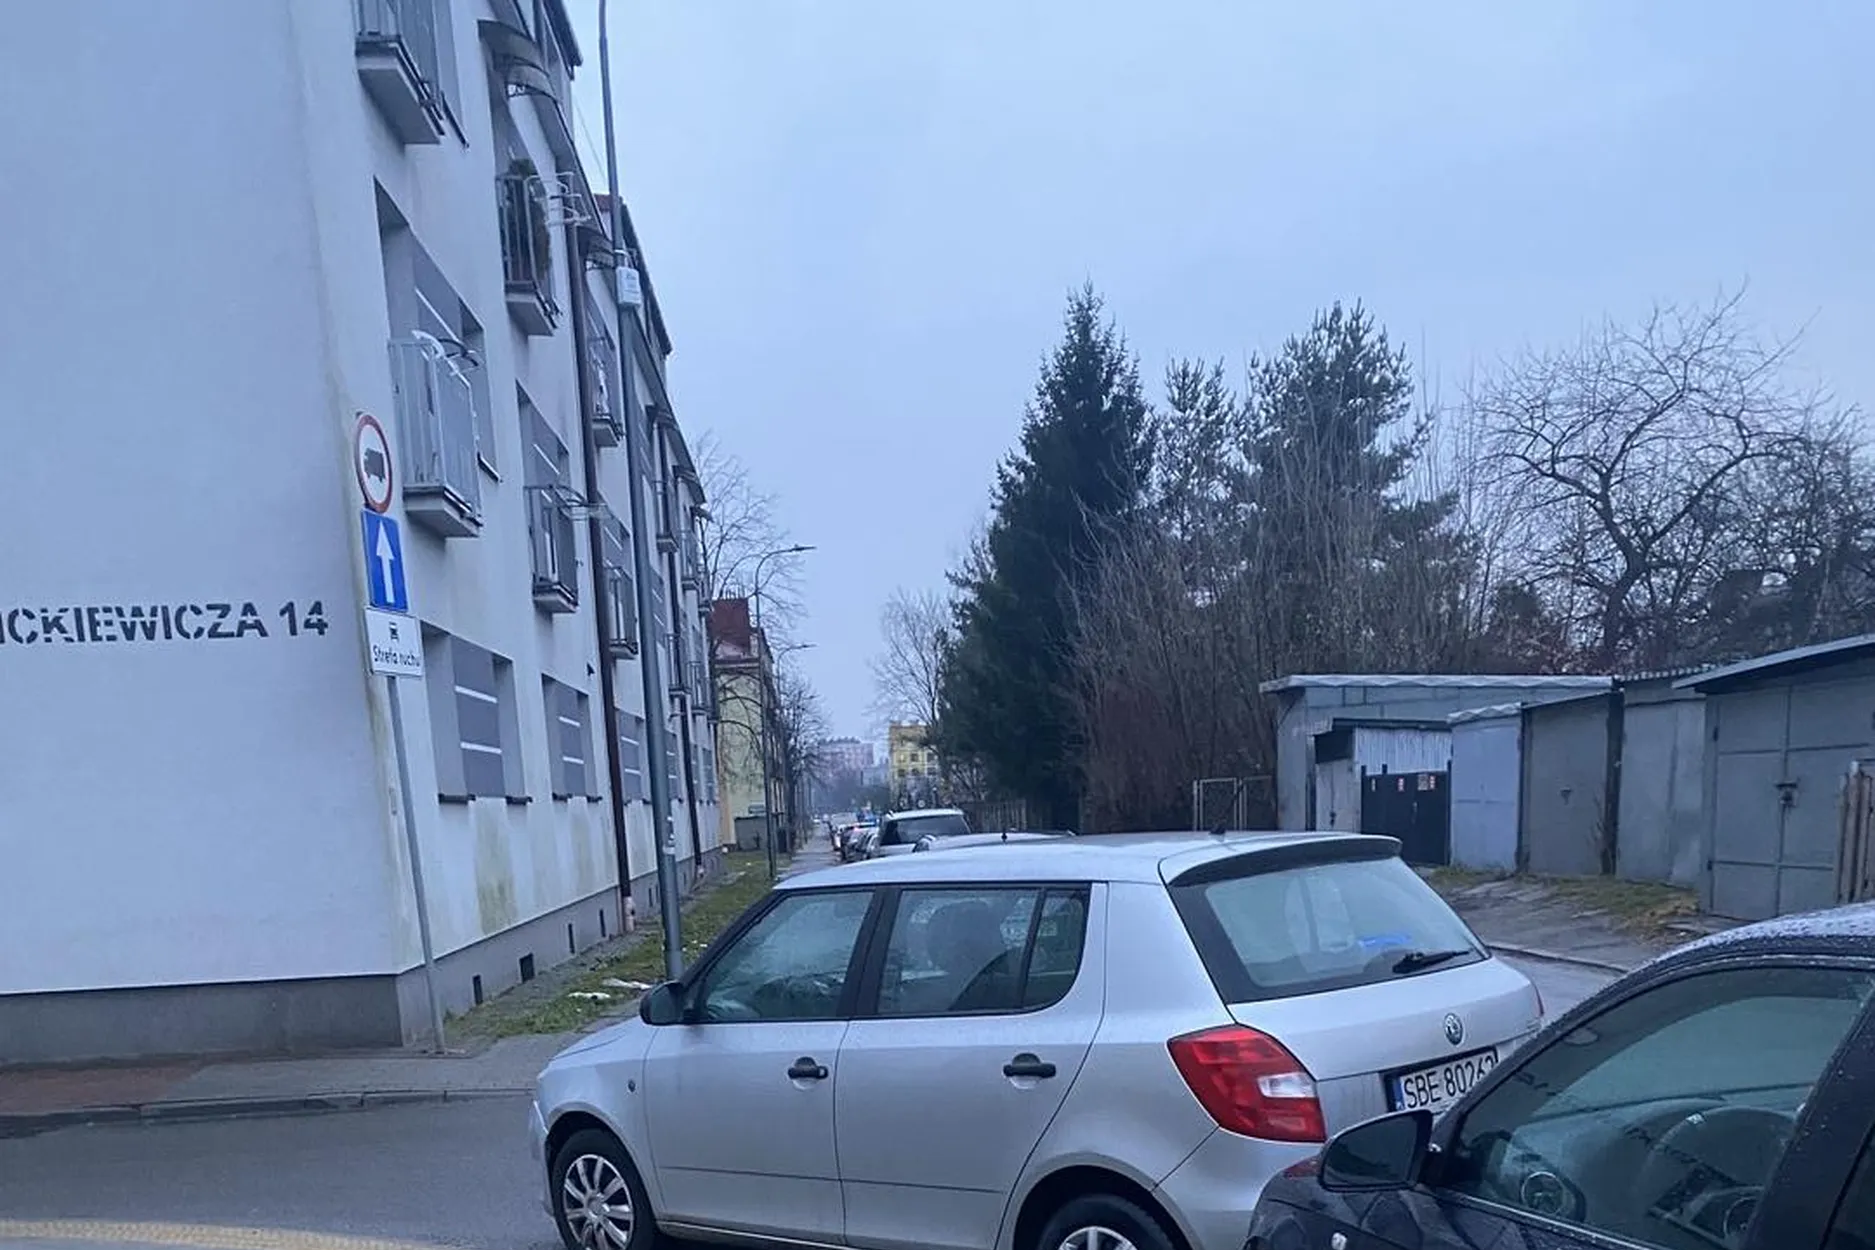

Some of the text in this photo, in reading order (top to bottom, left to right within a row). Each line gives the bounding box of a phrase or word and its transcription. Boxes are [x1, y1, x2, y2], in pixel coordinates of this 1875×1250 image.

[279, 601, 329, 636] 14
[373, 644, 398, 665] Strefa
[1403, 1070, 1441, 1108] SBE
